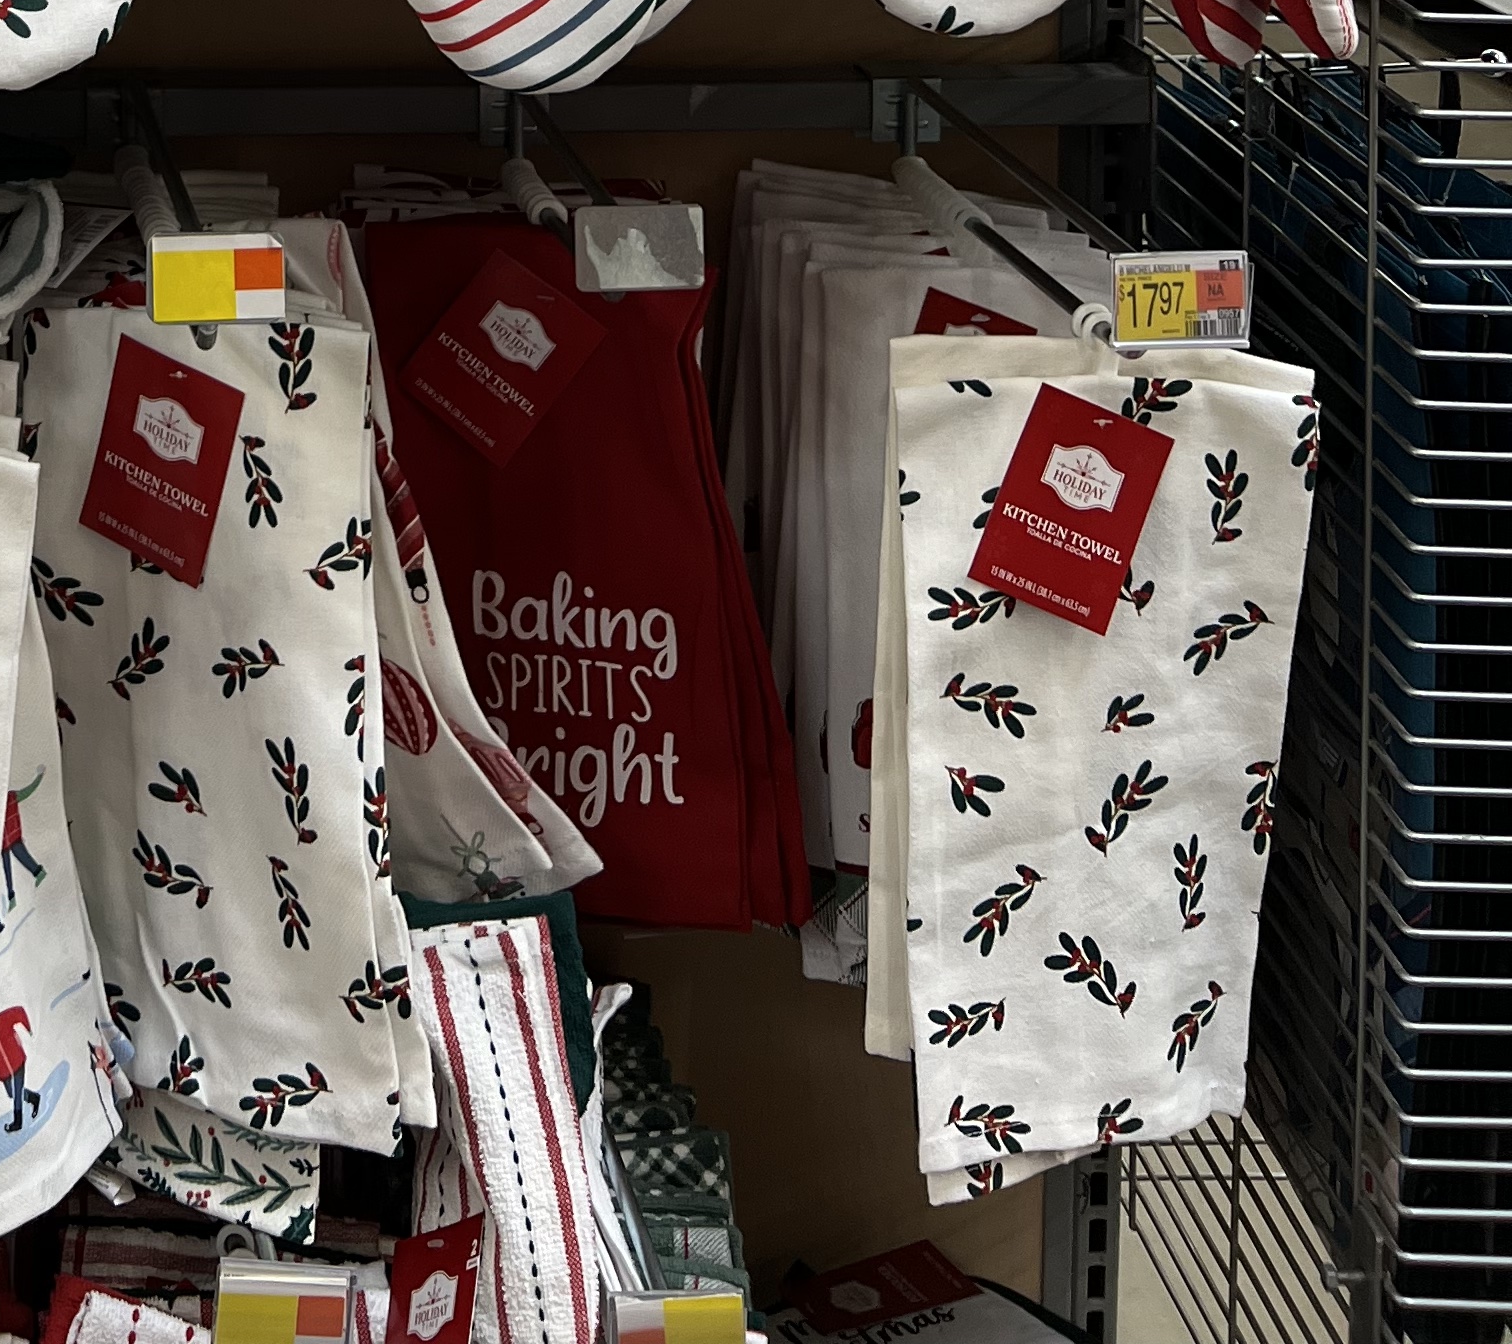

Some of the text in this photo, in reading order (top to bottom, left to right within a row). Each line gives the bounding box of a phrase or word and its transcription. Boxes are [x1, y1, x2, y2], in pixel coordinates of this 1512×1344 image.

[1207, 283, 1224, 296] NA
[490, 320, 536, 360] HOLIDAY
[438, 332, 492, 381] KITCHEN
[489, 374, 535, 416] TOWEL
[143, 420, 190, 453] HOLIDAY
[104, 450, 209, 517] KITCHEN TOWEL
[1053, 469, 1107, 501] HOLIDAY
[1063, 487, 1088, 503] TIME
[1002, 503, 1124, 565] KITCHEN TOWEL
[1027, 528, 1092, 561] TOALLA DE COCINA
[472, 569, 678, 679] Baking
[486, 652, 652, 722] SPIRITS
[470, 1239, 478, 1256] 2
[415, 1303, 448, 1325] HOLIDAY
